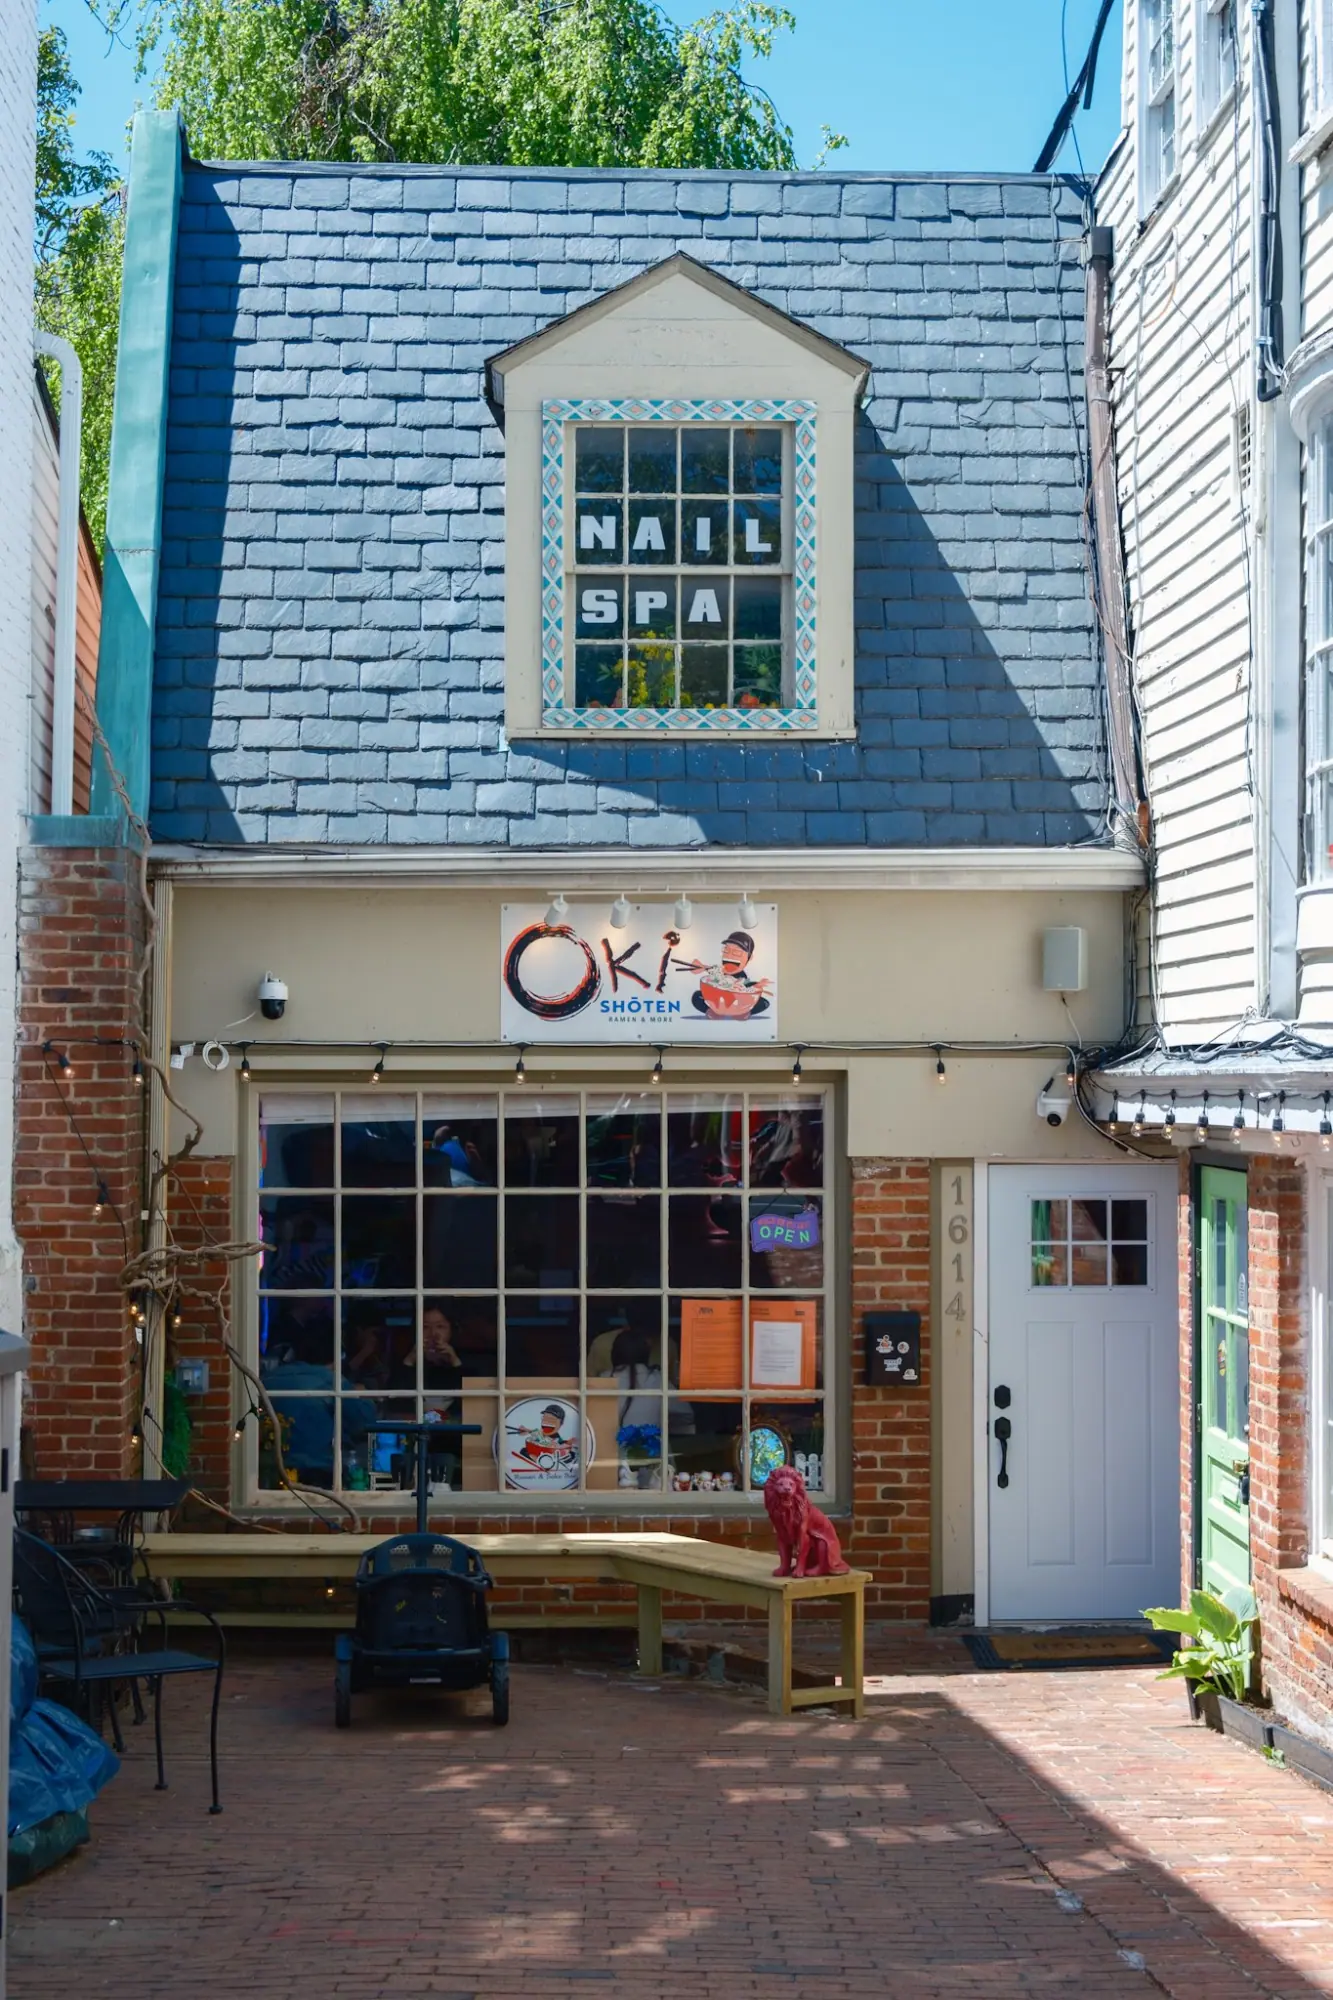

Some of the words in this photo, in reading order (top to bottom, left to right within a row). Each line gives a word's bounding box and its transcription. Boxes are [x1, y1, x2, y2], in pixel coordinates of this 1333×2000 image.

[580, 515, 772, 552] NAIL
[581, 589, 721, 624] SPA
[600, 996, 680, 1013] SHŌTEN
[759, 1225, 810, 1243] OPEN
[944, 1175, 969, 1322] 1614
